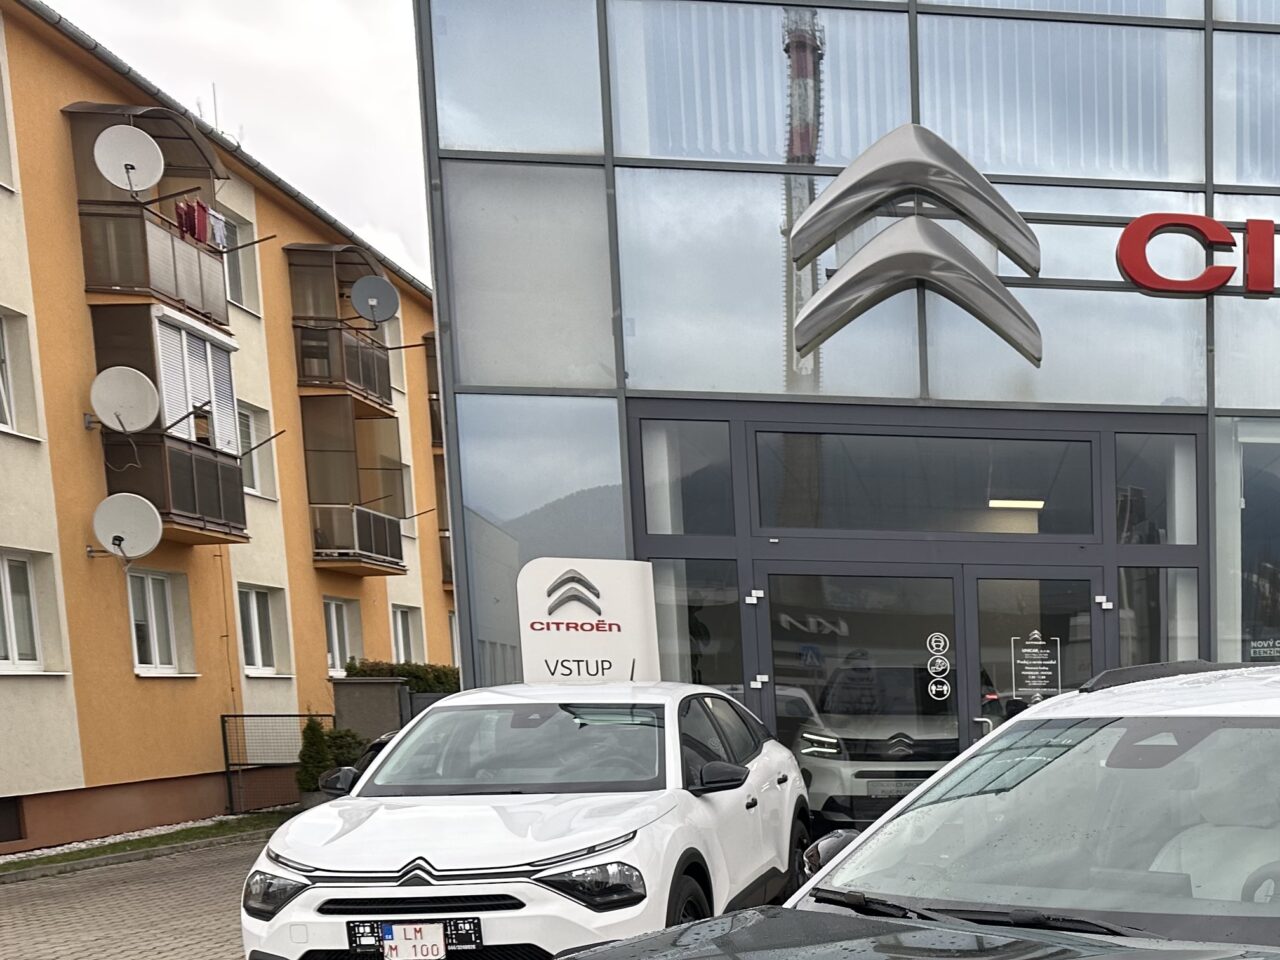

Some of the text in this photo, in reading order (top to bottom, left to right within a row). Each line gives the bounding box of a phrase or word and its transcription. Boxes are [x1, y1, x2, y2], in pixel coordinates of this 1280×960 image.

[1251, 638, 1274, 648] NOVÝ
[544, 659, 612, 677] VSTUP
[403, 927, 423, 941] LM
[389, 944, 440, 958] M 100
